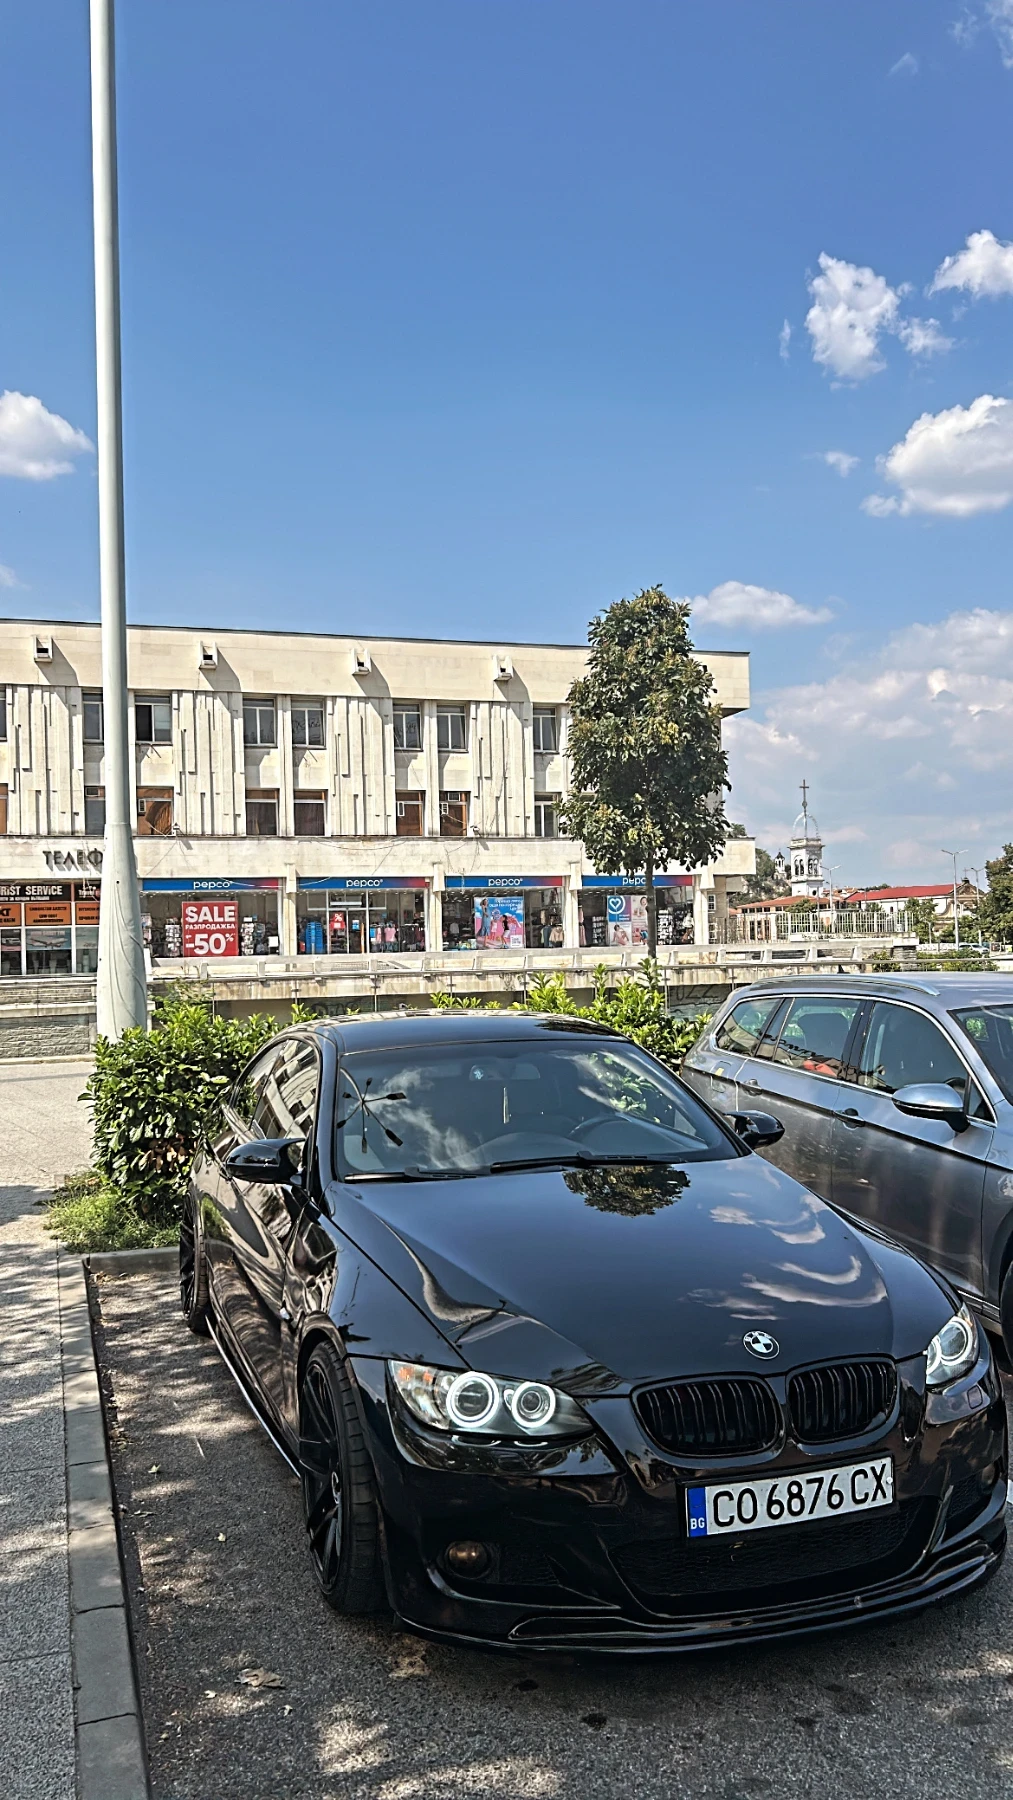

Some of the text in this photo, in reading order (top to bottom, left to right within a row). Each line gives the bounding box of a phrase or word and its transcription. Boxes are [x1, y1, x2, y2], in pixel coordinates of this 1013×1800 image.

[193, 881, 230, 889] pepco
[346, 879, 380, 887] pepco
[488, 878, 520, 886] pepco
[185, 906, 235, 923] SALE
[185, 933, 235, 955] -50%
[713, 1463, 887, 1527] CO 6876 CX
[690, 1517, 705, 1530] BG
